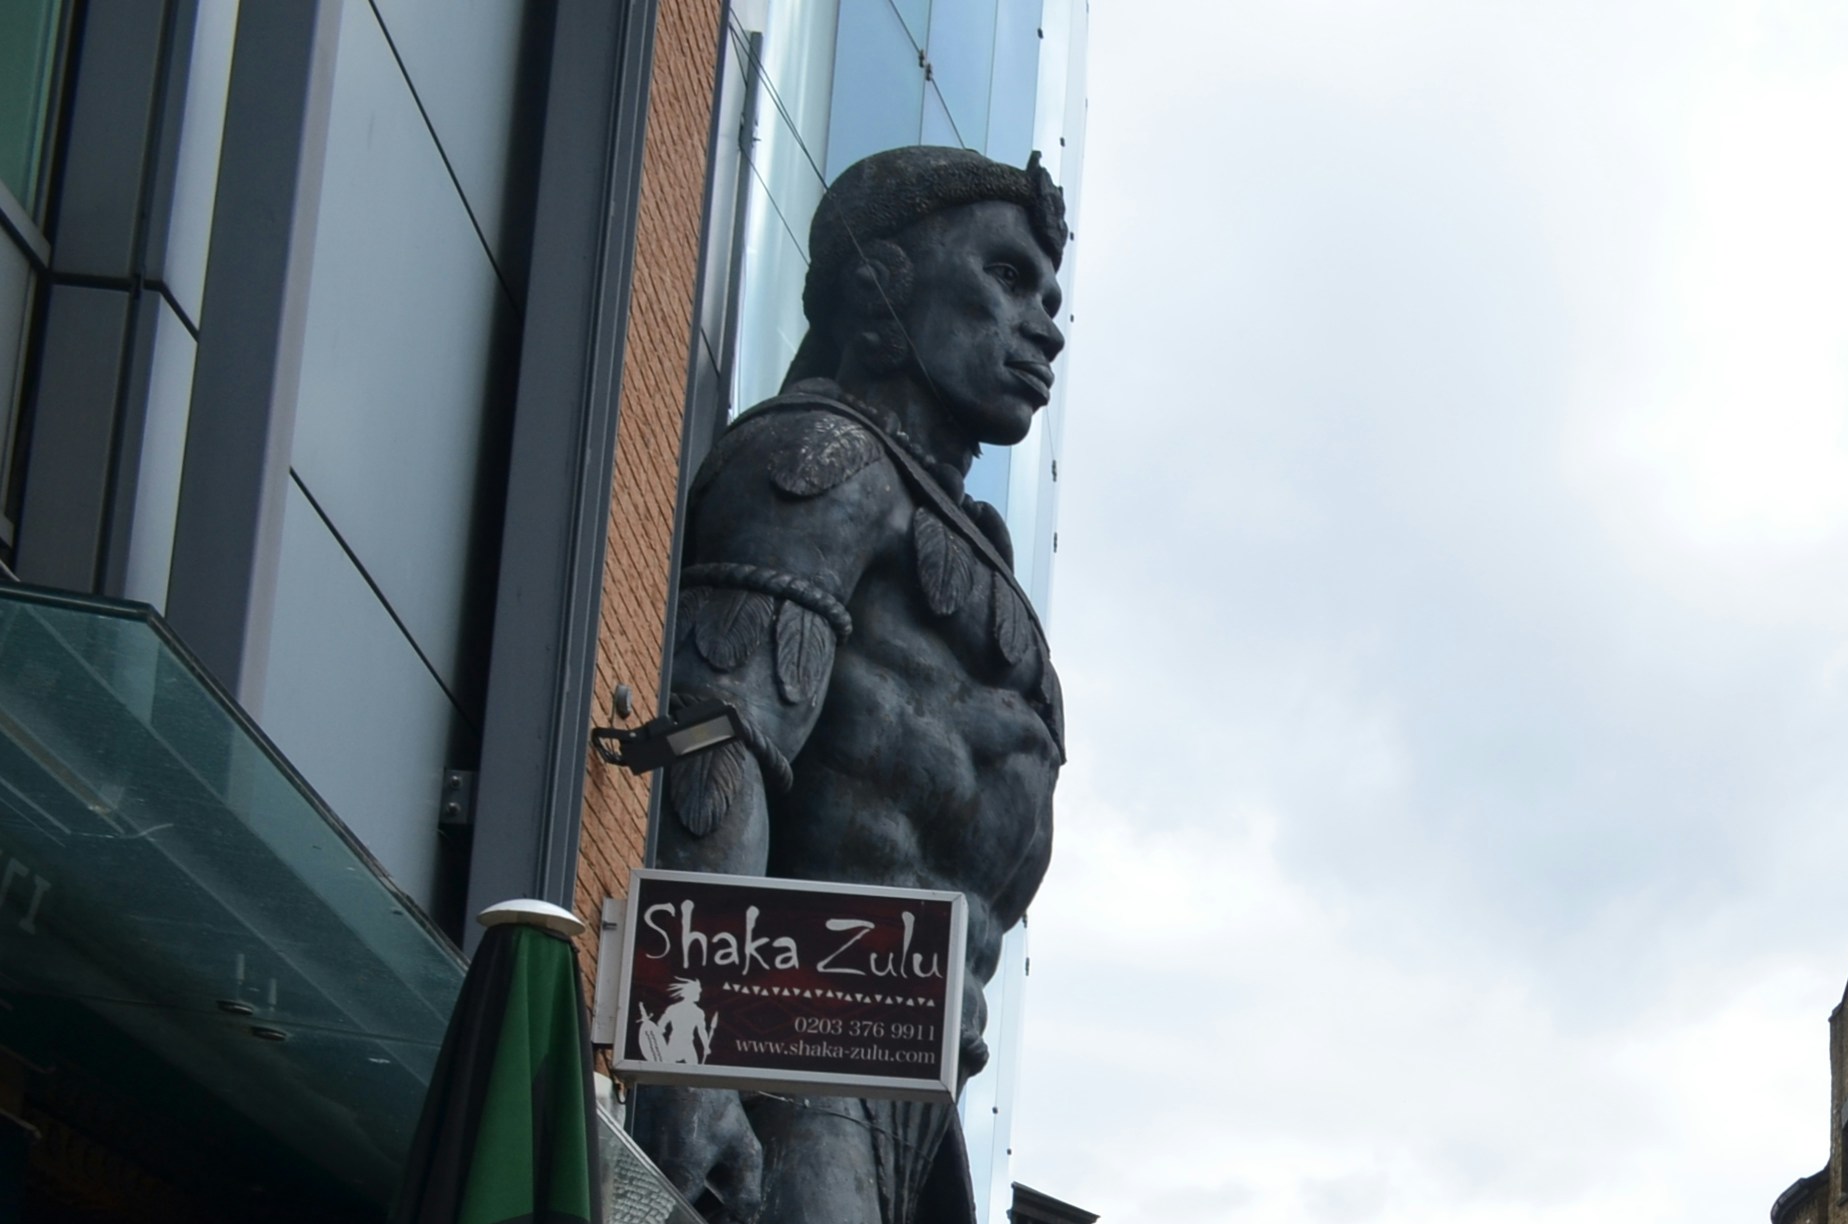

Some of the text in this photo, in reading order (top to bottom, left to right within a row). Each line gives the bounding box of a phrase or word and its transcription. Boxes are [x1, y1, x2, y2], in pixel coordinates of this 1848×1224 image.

[643, 899, 944, 979] Shaka Zulu
[795, 1017, 935, 1041] 0203 376 9911
[736, 1040, 936, 1065] www.shaka-zulu.com
